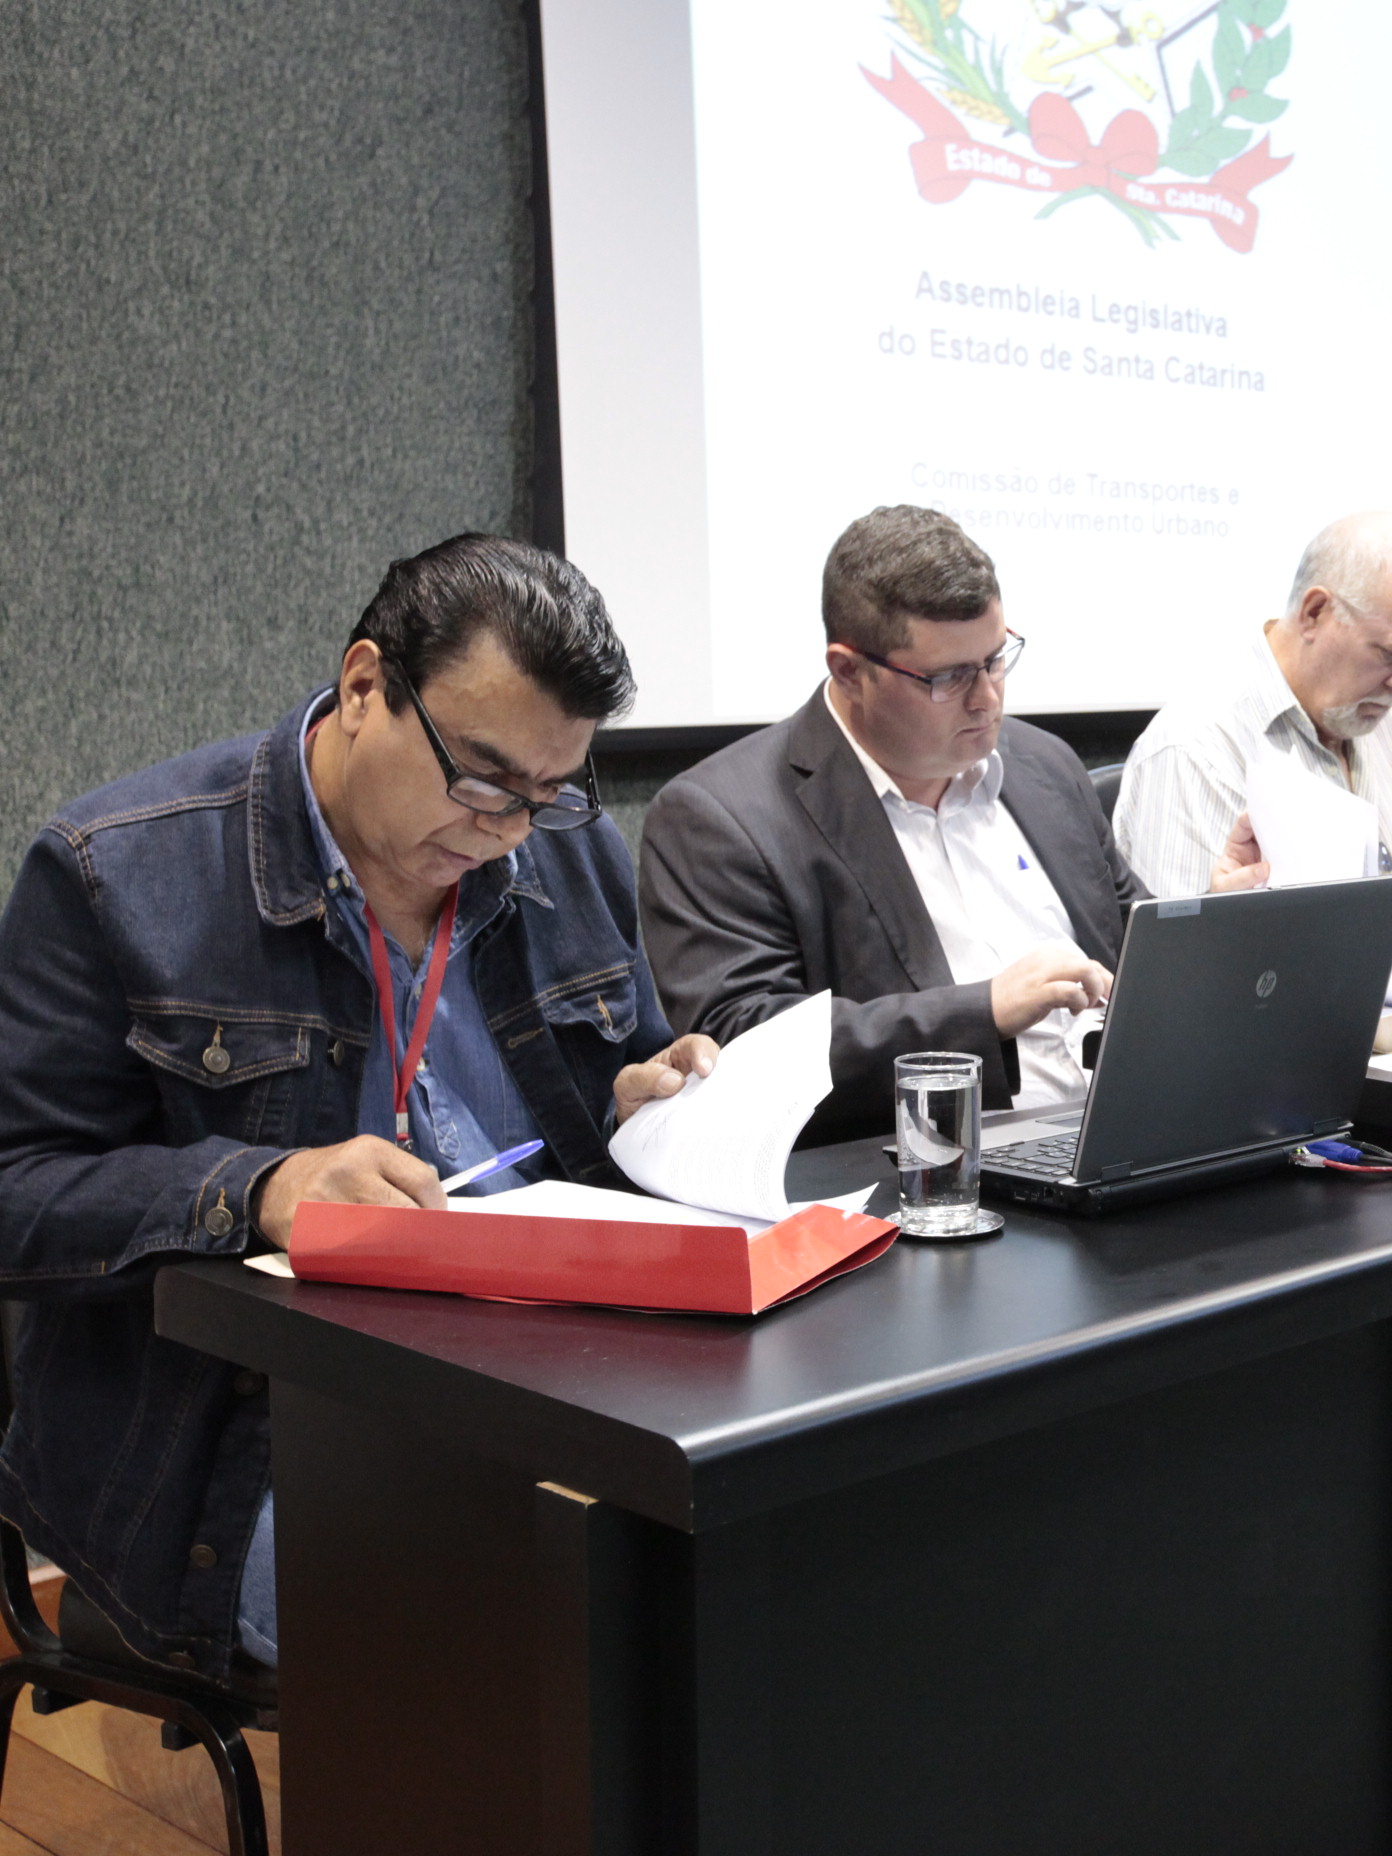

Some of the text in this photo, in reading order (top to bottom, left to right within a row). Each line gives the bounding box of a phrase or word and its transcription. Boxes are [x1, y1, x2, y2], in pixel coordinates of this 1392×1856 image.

[944, 143, 1053, 188] Estado de
[1126, 182, 1246, 225] Sta. Catarina
[915, 270, 1229, 338] Assembleia Legislativa
[878, 325, 1266, 392] do Estado de Santa Catarina
[911, 462, 1240, 505] Comissão de Transportes e
[1151, 510, 1230, 537] Urbano
